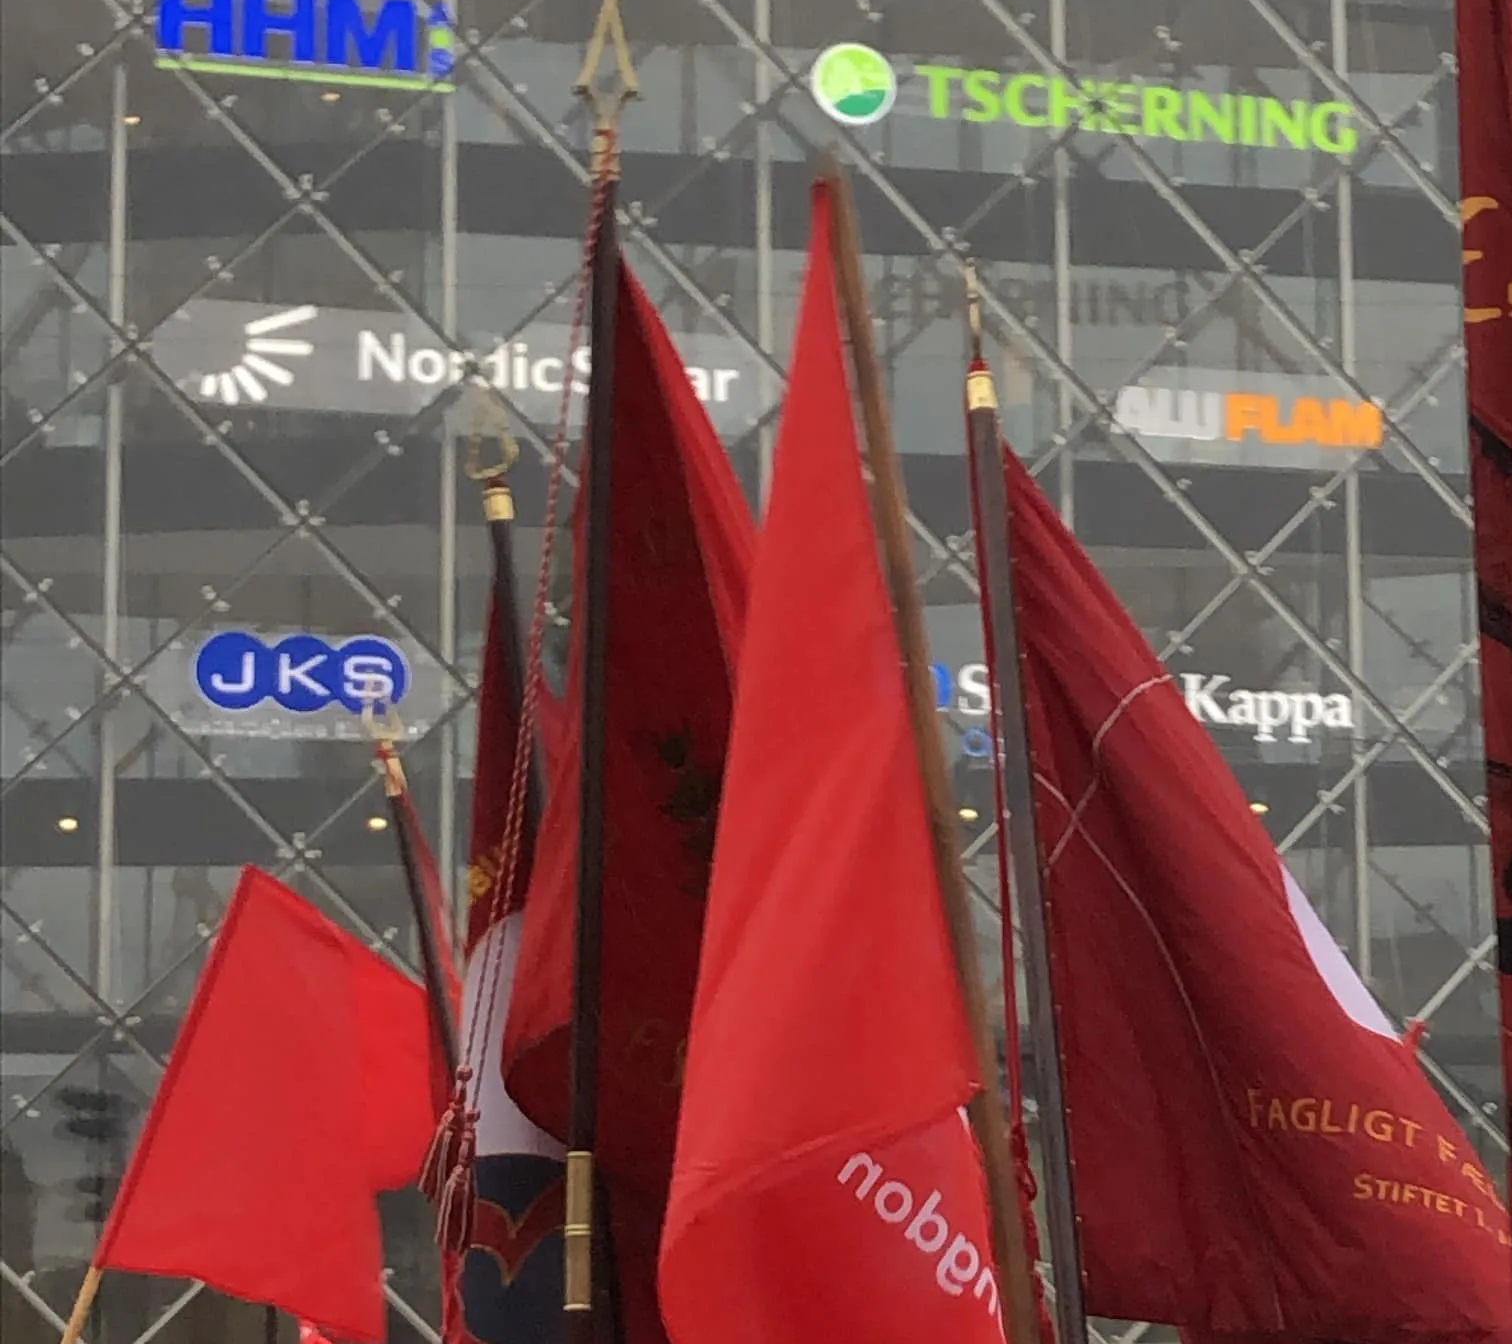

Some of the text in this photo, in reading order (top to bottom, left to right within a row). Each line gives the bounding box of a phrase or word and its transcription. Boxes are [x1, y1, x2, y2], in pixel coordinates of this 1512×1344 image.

[915, 65, 1357, 155] TSCHERNING
[210, 652, 393, 703] JKS
[1181, 673, 1355, 743] Kappa
[1247, 1088, 1423, 1147] FAGLIGT
[1353, 1173, 1468, 1217] STIFTET
